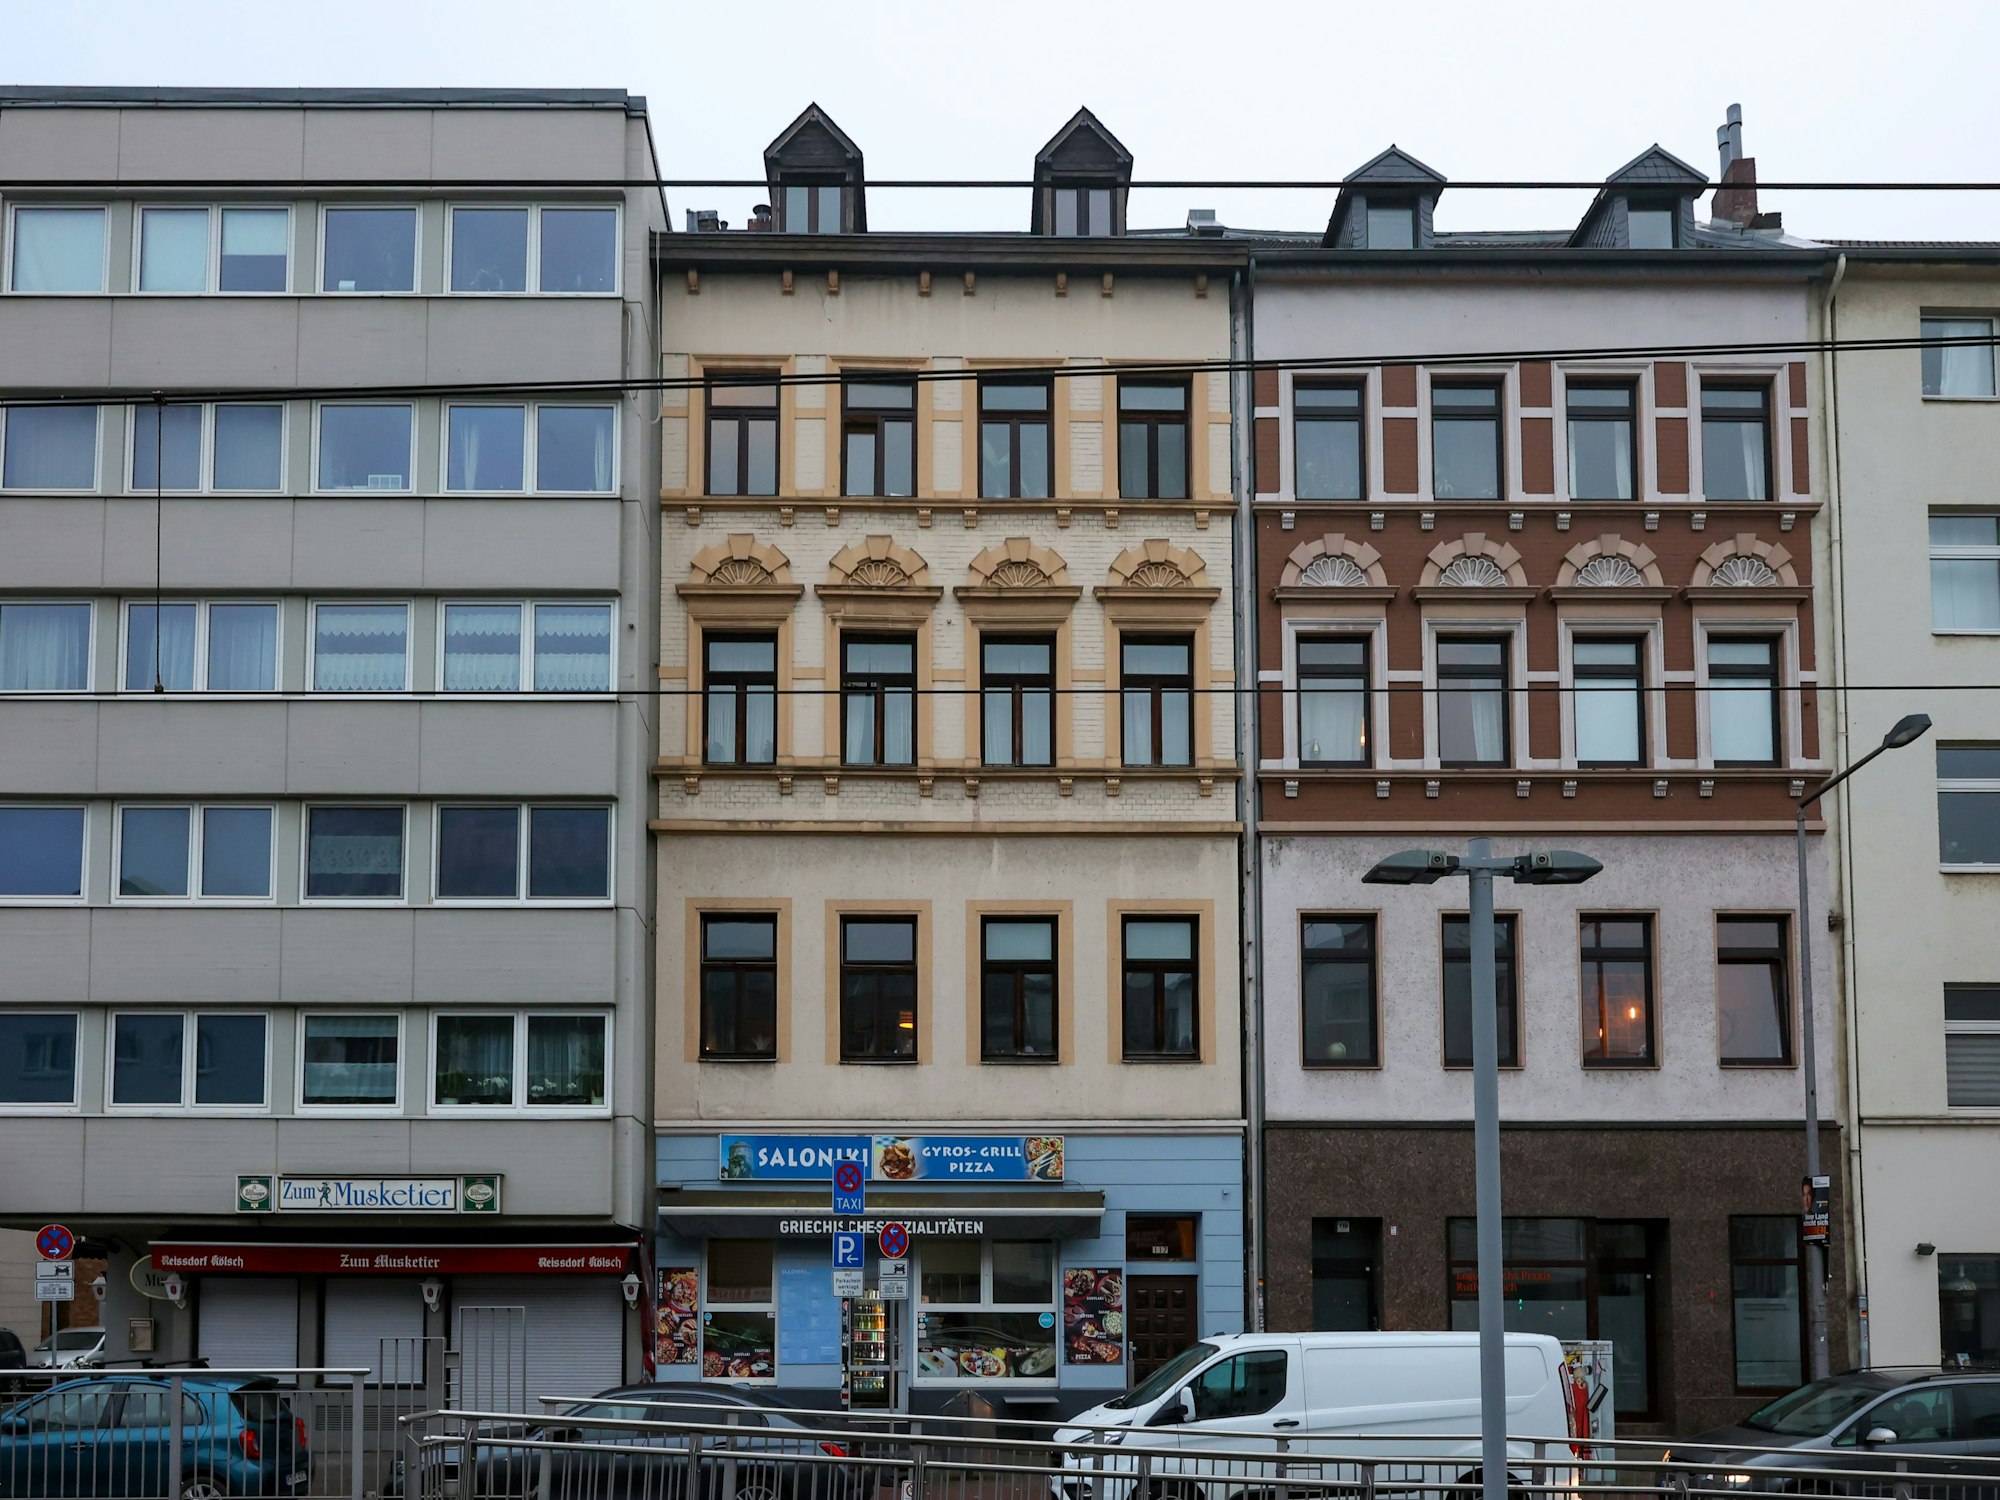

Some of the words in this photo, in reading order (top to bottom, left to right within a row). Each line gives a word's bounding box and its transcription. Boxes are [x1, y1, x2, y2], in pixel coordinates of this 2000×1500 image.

[758, 1147, 869, 1167] SALONIKI
[922, 1146, 977, 1158] GYROS-
[980, 1145, 1022, 1158] GRILL
[950, 1162, 994, 1174] PIZZA
[283, 1181, 316, 1200] Zum
[333, 1180, 452, 1207] Musketier
[836, 1197, 861, 1210] TAXI
[838, 1236, 855, 1264] P
[161, 1255, 208, 1267] Reissdorf
[211, 1254, 244, 1268] Kölsch
[340, 1254, 370, 1268] Zum
[373, 1254, 441, 1268] Musketier
[538, 1256, 586, 1268] Reissdorf
[588, 1256, 622, 1269] Kölsch
